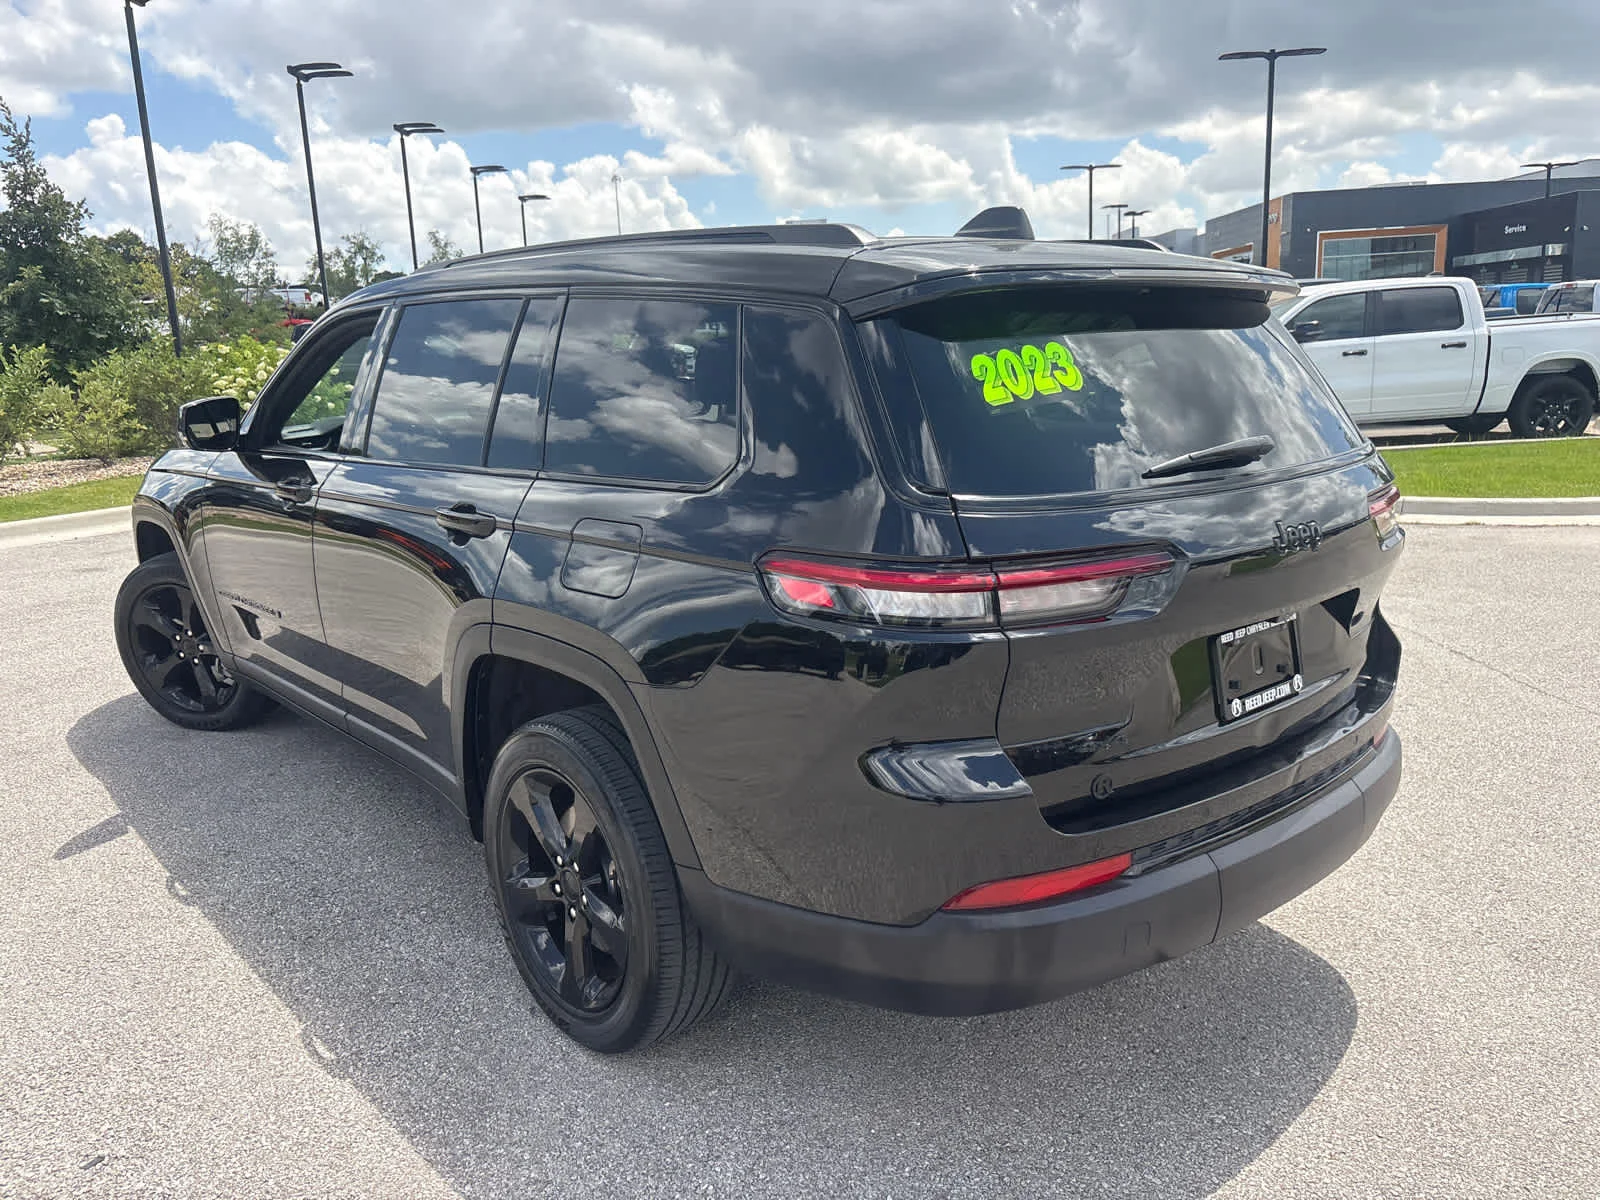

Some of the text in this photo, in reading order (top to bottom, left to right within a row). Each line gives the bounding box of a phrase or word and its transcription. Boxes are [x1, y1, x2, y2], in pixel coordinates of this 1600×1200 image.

[1504, 223, 1527, 235] Service
[971, 341, 1083, 407] 2023
[1272, 519, 1321, 554] Jeep
[1221, 621, 1270, 644] REED JEEP CHRYSLER
[1245, 682, 1291, 712] REEDJEEP.COM
